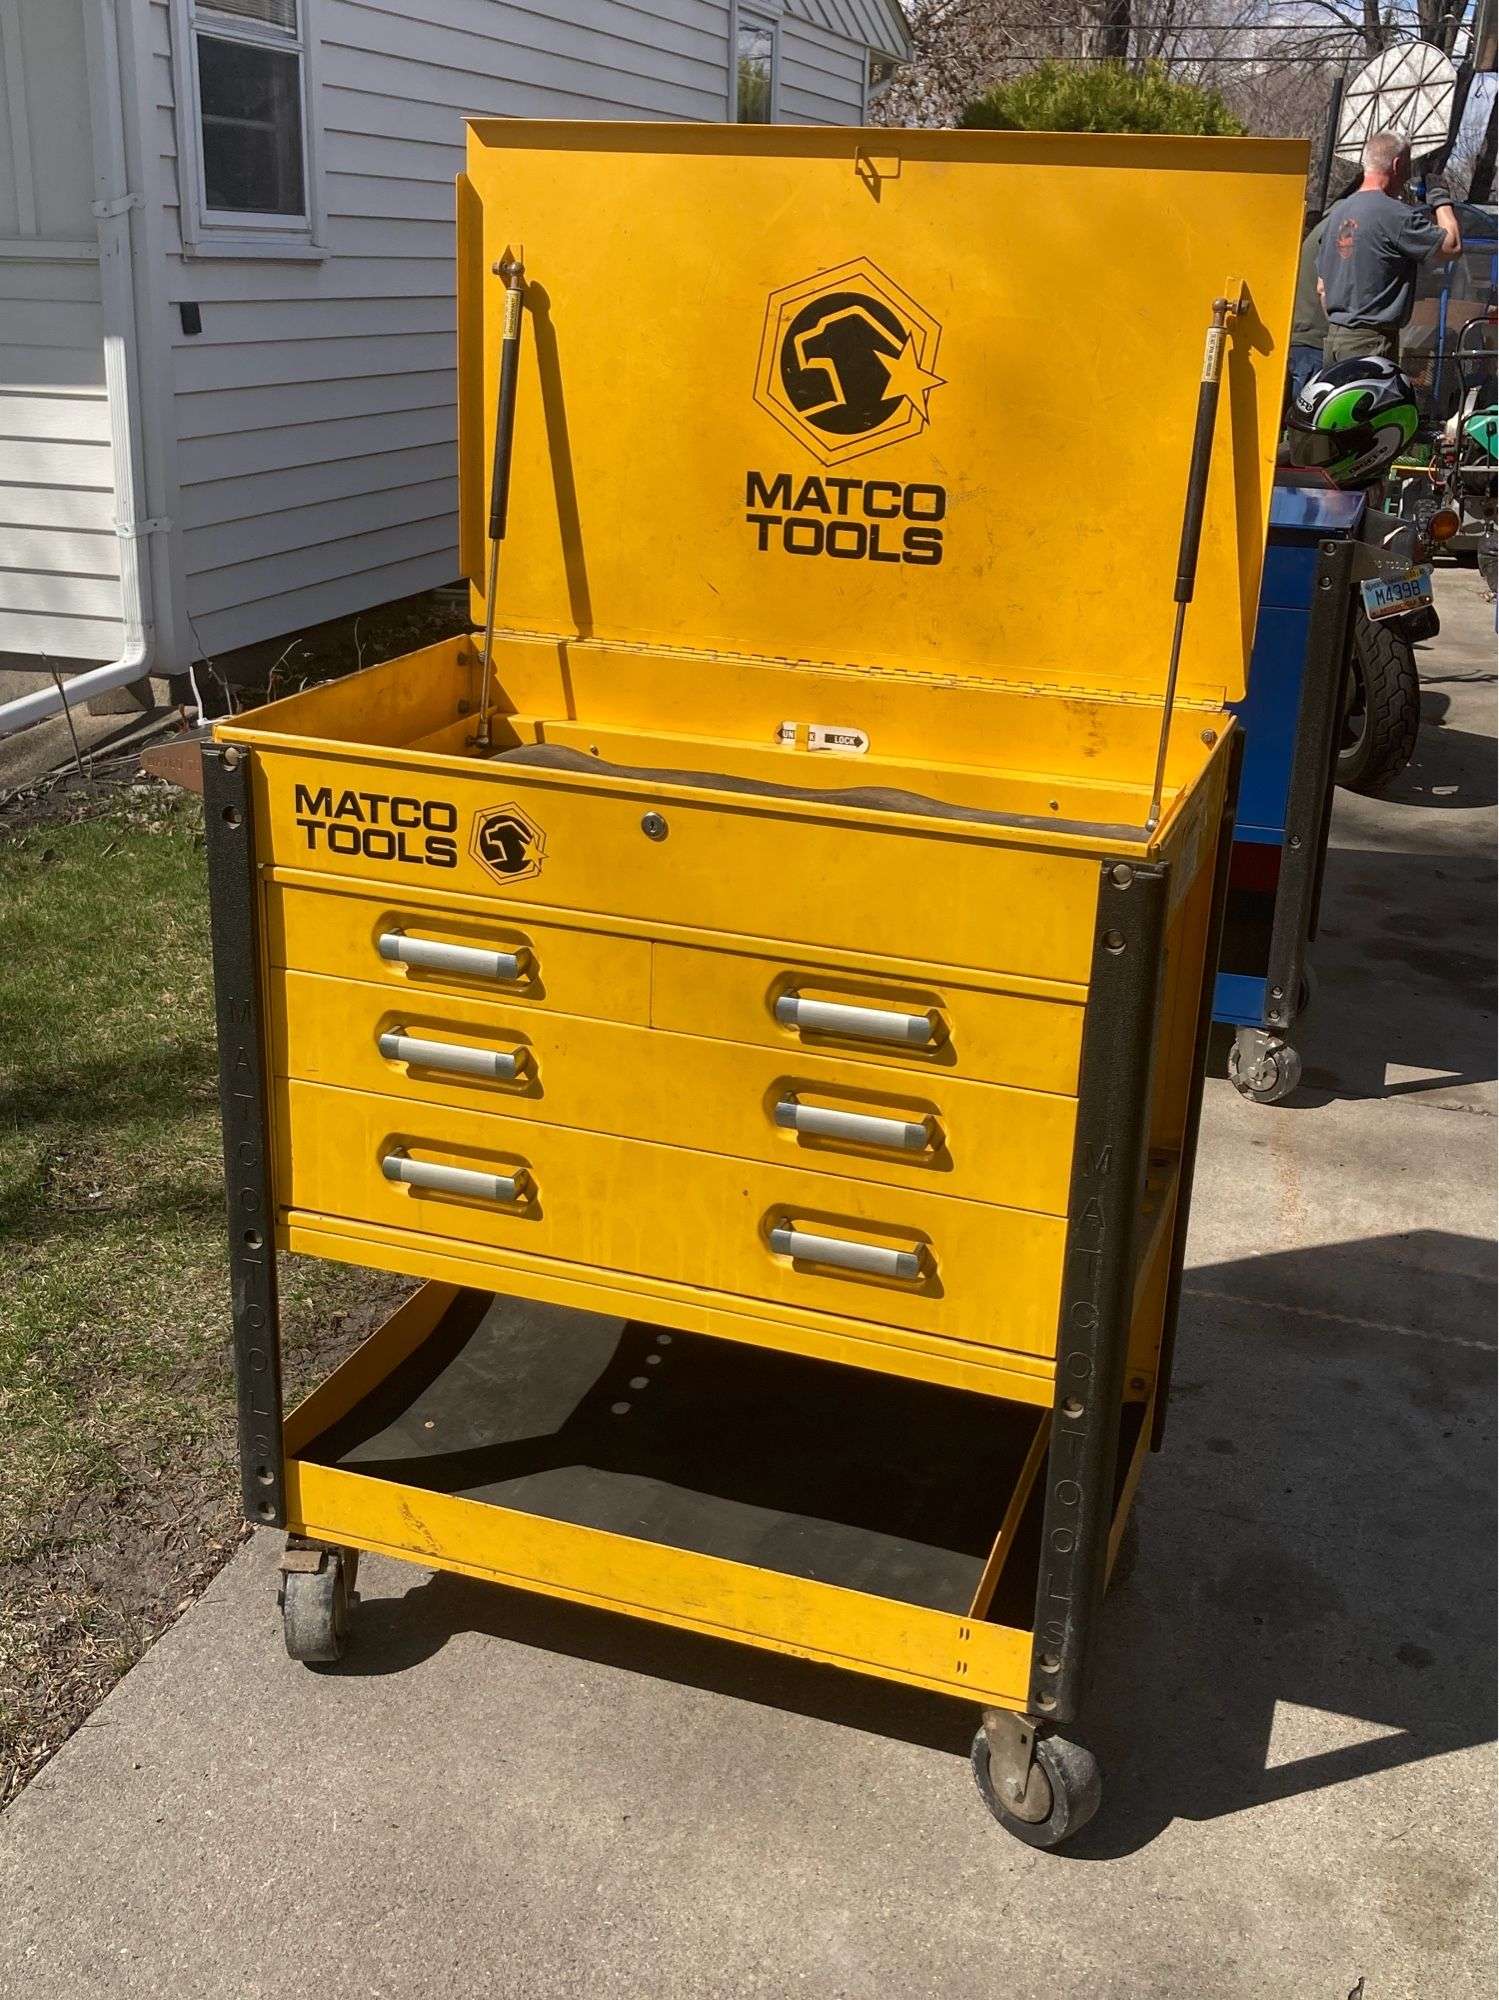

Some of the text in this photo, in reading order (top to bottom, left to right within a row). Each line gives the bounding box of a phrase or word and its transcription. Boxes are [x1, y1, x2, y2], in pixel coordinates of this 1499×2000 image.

[746, 470, 947, 522] MATCO
[746, 513, 944, 566] TOOLS
[834, 735, 857, 746] LOCK
[295, 784, 457, 833] MATCO
[296, 818, 457, 868] TOOLS
[229, 996, 270, 1457] MATCO TOOLS
[1043, 1141, 1114, 1646] MATCO TOOLS
